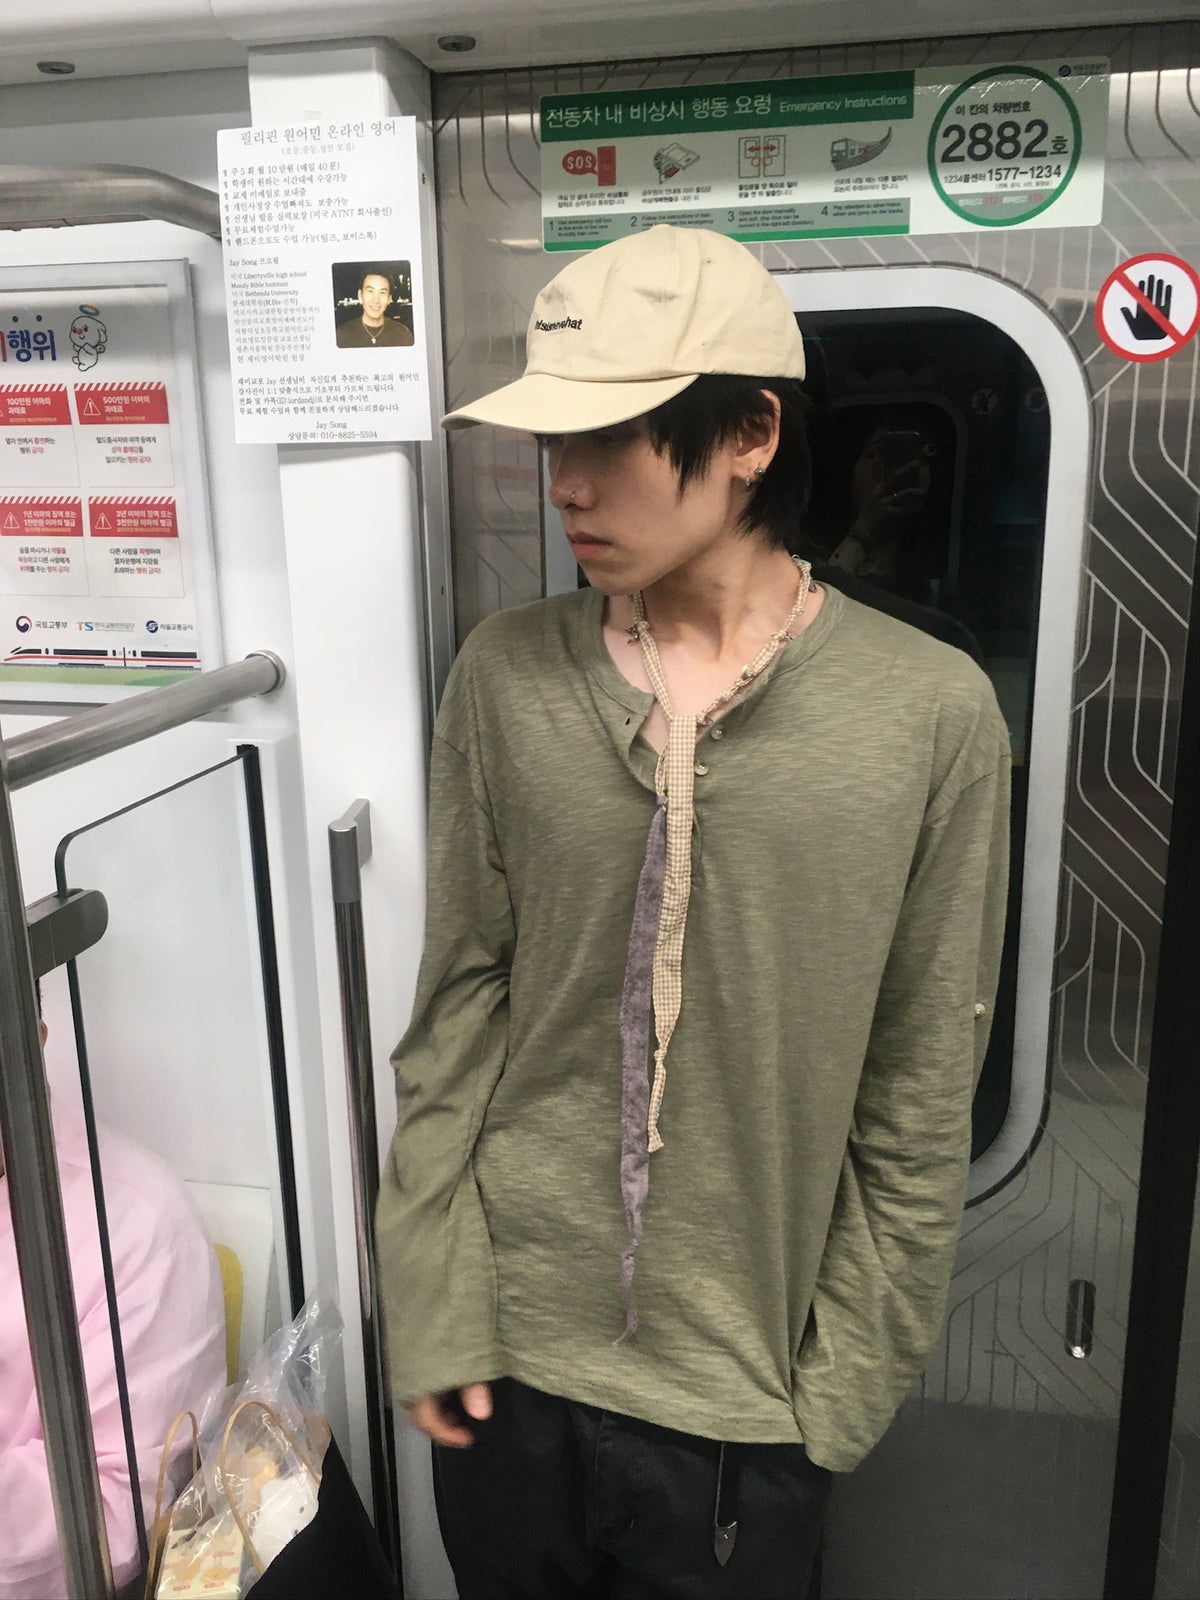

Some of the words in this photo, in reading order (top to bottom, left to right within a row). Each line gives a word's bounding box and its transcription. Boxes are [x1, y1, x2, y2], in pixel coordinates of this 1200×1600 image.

[545, 104, 600, 128] 전동차
[606, 104, 622, 123] 내
[630, 100, 686, 122] 비상시
[692, 96, 729, 120] 행동
[735, 93, 772, 116] 요령
[780, 98, 841, 114] Emergency
[844, 94, 908, 109] Instructions
[956, 104, 966, 116] 이
[970, 103, 989, 115] 칸의
[992, 101, 1031, 114] 차량번호
[284, 126, 321, 143] 원어민
[328, 122, 364, 138] 온라인
[371, 120, 396, 136] 영어
[566, 155, 593, 170] SOS
[317, 173, 348, 183] 수강가능
[944, 173, 986, 183] 1234콜센터
[988, 164, 1061, 181] 1577-1234
[728, 210, 735, 222] 3
[821, 205, 828, 217] 4
[234, 213, 256, 223] 선생님
[631, 216, 638, 227] 2
[549, 221, 554, 231] 1
[230, 259, 240, 267] Jay
[316, 421, 327, 430] Jay
[330, 420, 347, 429] Song
[320, 431, 377, 439] 010-8825-5594
[77, 622, 94, 632] TS
